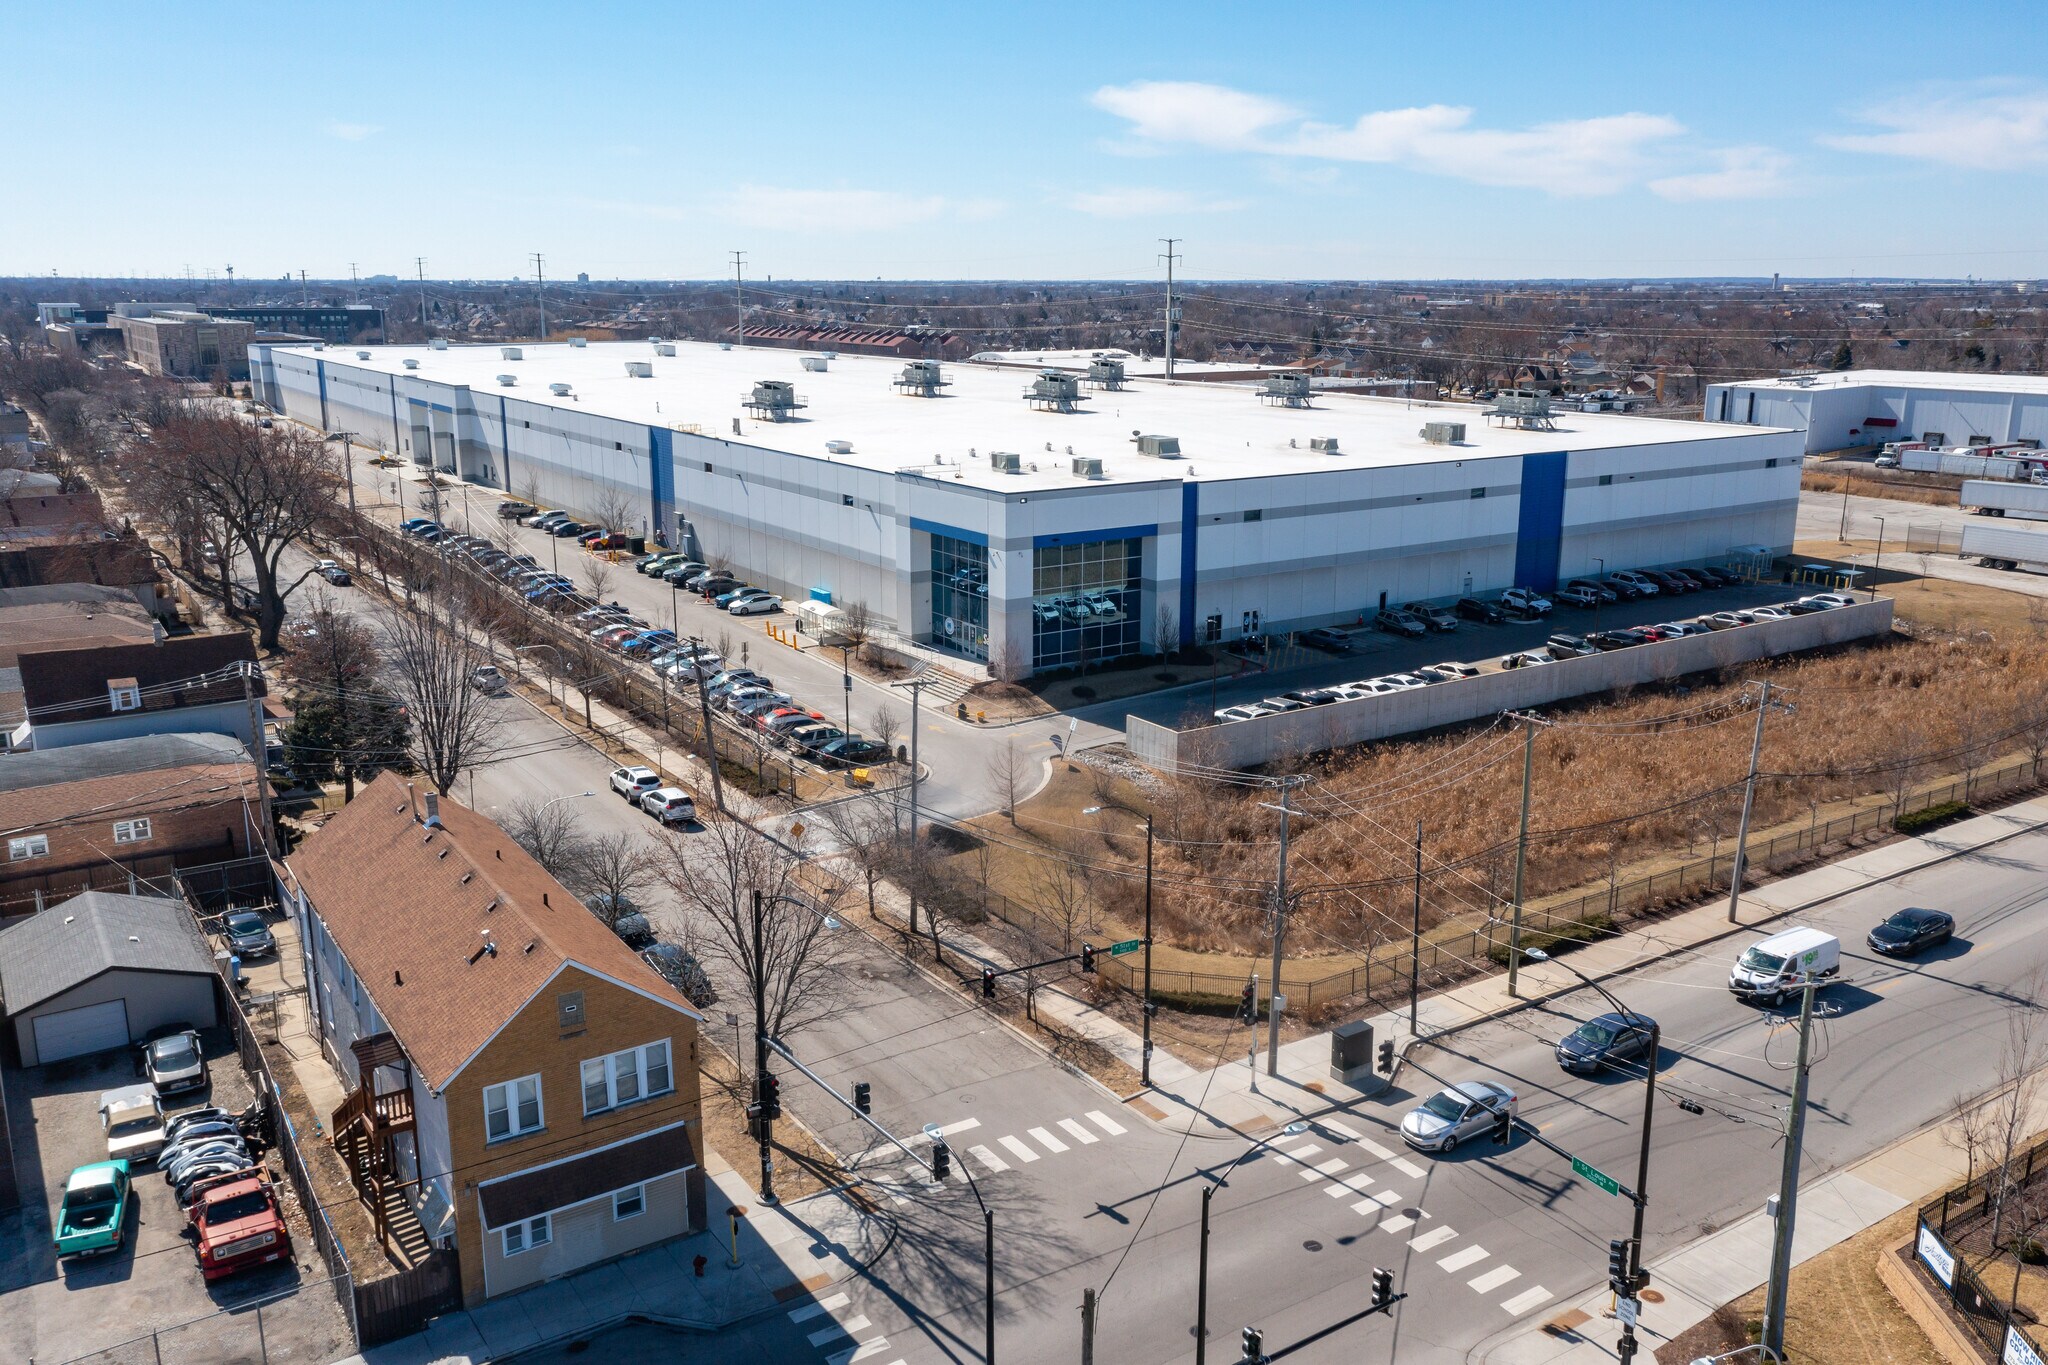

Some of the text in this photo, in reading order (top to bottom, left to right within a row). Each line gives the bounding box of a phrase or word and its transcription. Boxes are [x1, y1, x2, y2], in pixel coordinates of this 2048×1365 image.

[1590, 1169, 1606, 1183] Louis
[1618, 1304, 1635, 1318] SCHOOL
[1622, 1300, 1632, 1308] END
[1620, 1311, 1632, 1322] ZONE
[2009, 1338, 2023, 1358] CDL
[2012, 1331, 2030, 1354] NOW
